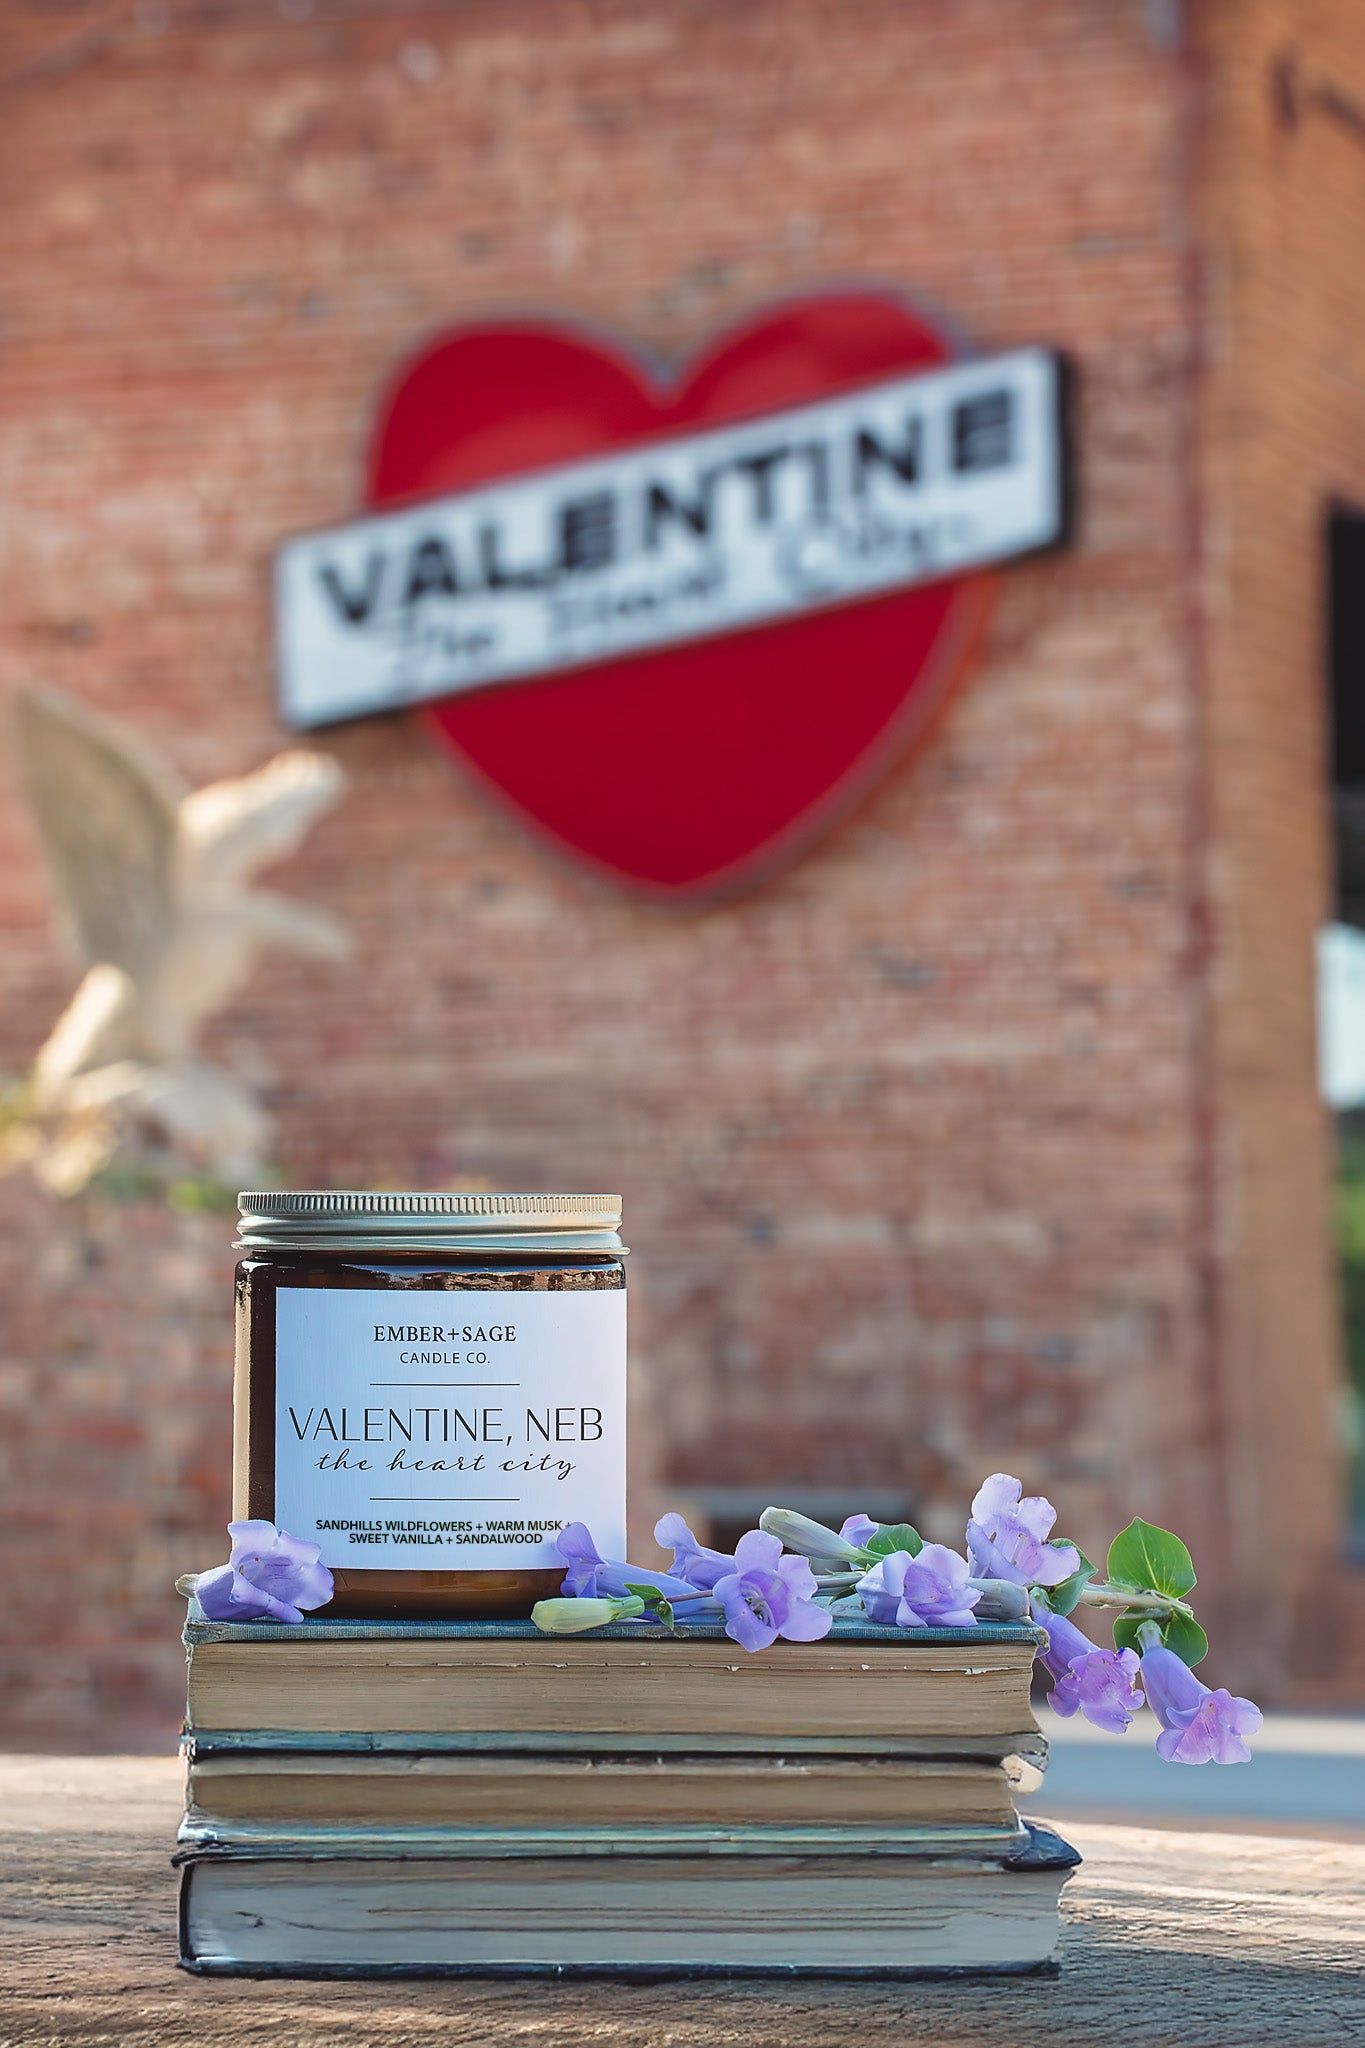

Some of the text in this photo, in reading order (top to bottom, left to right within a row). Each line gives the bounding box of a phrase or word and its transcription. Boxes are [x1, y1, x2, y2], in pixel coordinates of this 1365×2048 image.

[316, 384, 1016, 627] VALENTINE
[373, 1325, 517, 1343] EMBER+SAGE
[399, 1351, 491, 1365] CANDLE CO.
[288, 1406, 604, 1447] VALENTINE, NEB
[314, 1448, 577, 1481] the heart city
[315, 1519, 383, 1532] SANDHILLS
[385, 1520, 472, 1532] WILDFLOWERS
[475, 1523, 483, 1532] +
[485, 1521, 524, 1532] WARM
[527, 1520, 563, 1531] MUSK
[348, 1532, 543, 1545] SWEET VANILLA + SANDALWOOD
